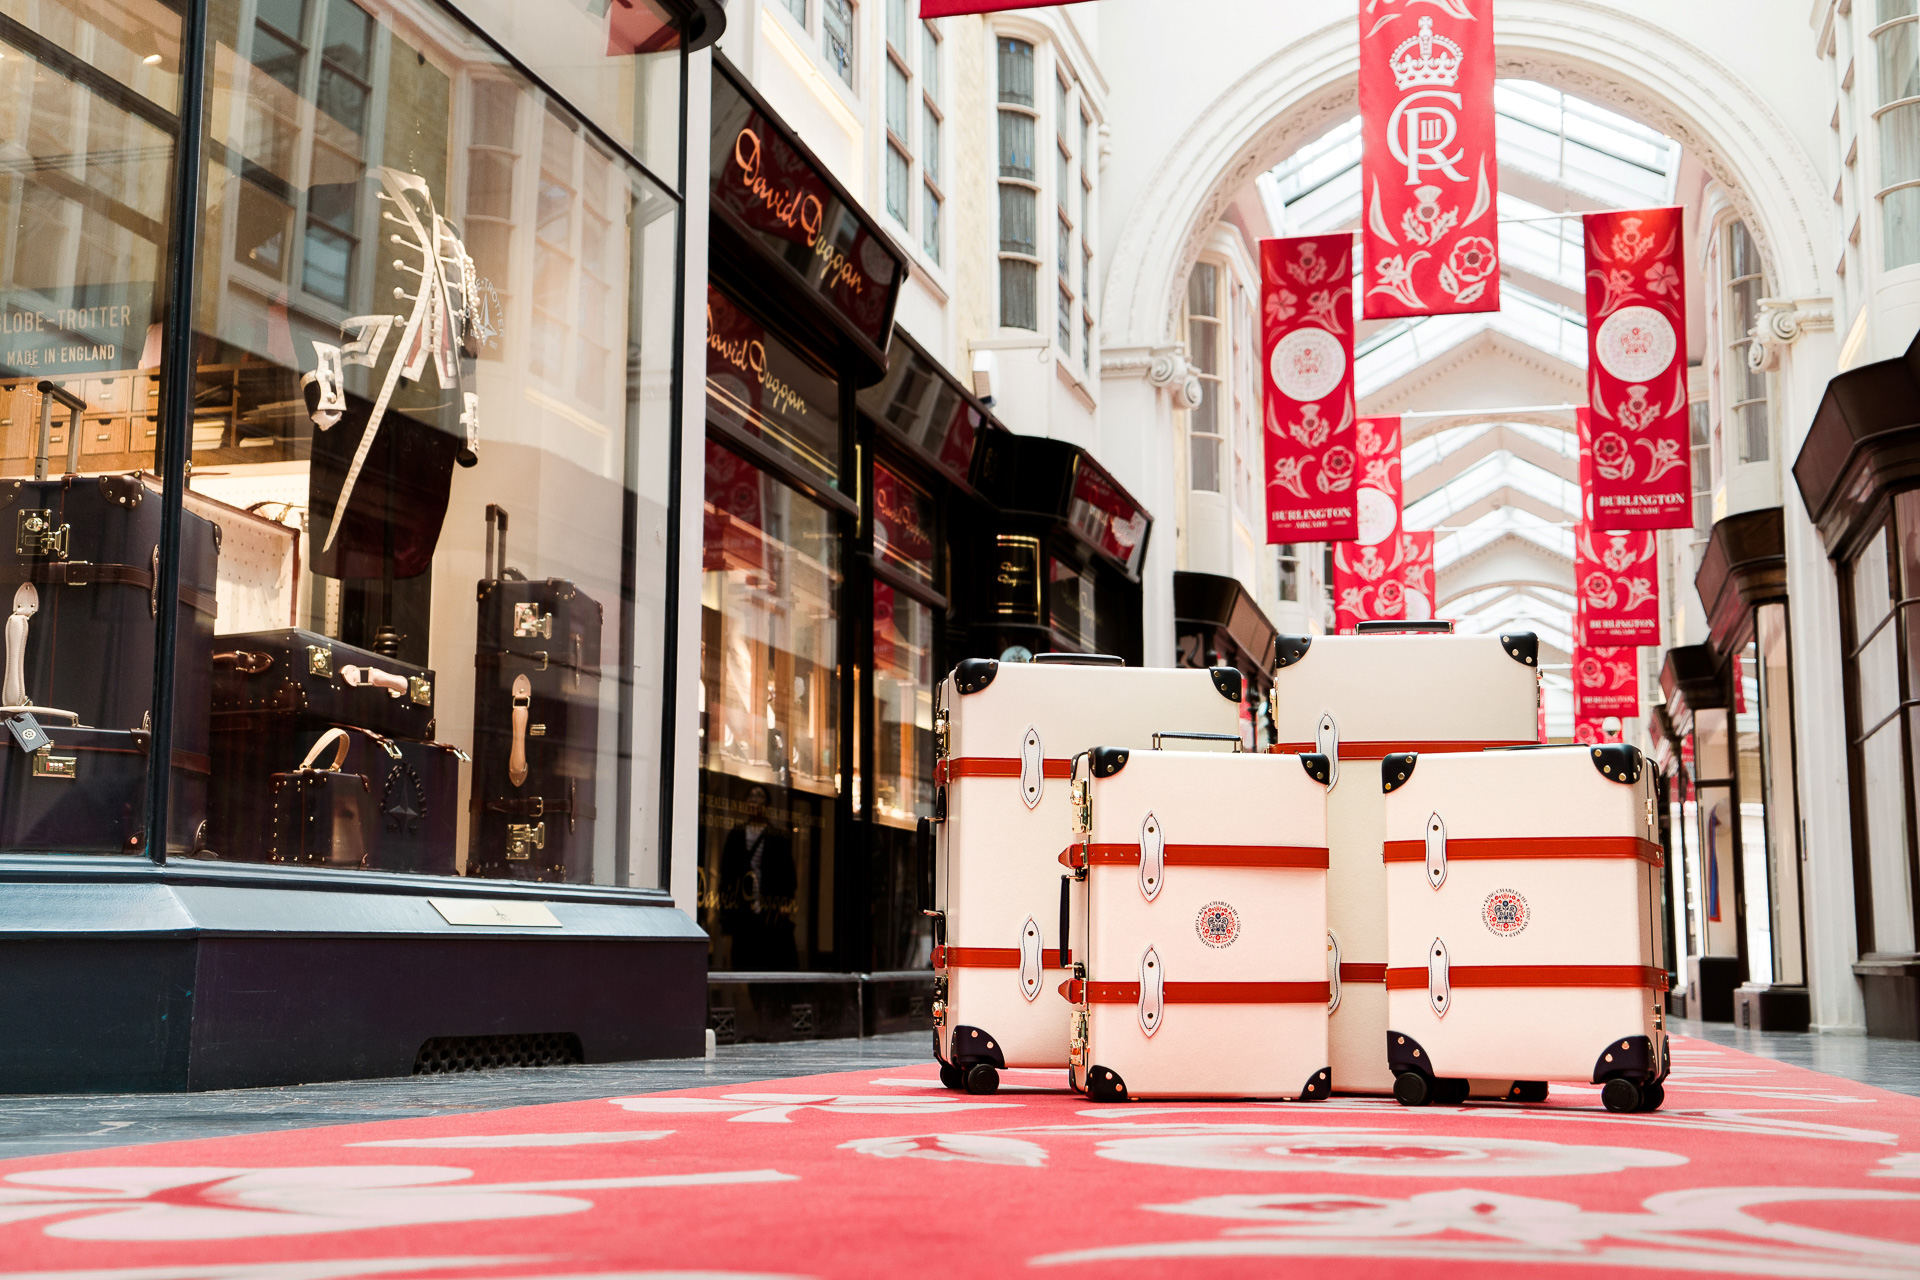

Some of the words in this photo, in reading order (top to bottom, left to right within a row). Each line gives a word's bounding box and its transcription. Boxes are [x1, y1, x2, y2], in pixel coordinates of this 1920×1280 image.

[736, 128, 802, 229] David
[800, 194, 863, 294] Duggan
[7, 349, 39, 366] MADE
[44, 348, 56, 363] IN
[61, 343, 115, 363] ENGLAND
[749, 340, 807, 415] Duggan
[1599, 493, 1685, 507] BURLINGTON
[1271, 507, 1352, 521] BURLINGTON
[1589, 618, 1656, 629] BURLINGTON
